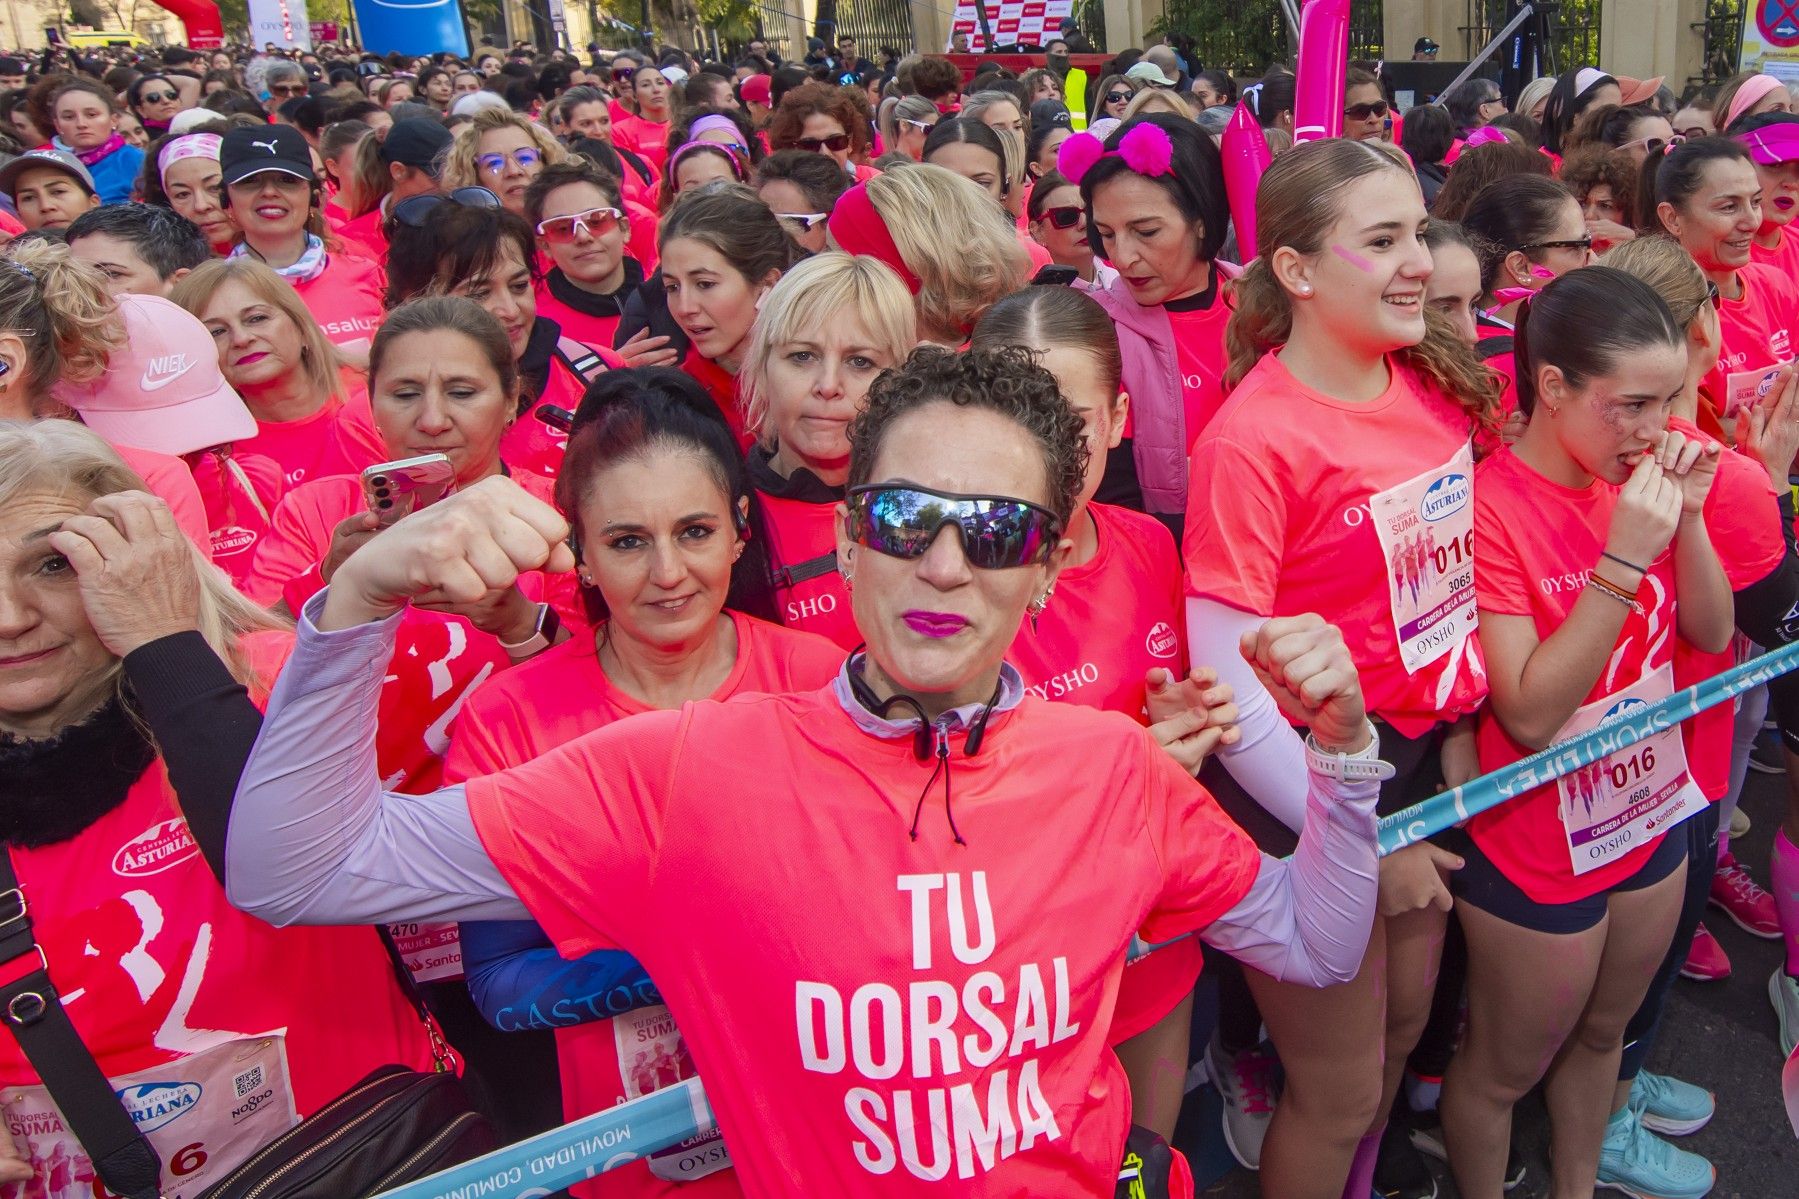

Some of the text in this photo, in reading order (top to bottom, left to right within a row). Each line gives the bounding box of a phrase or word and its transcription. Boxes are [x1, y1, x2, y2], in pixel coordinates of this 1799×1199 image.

[1391, 515, 1420, 536] SUMA
[1448, 572, 1471, 594] 3065
[1417, 607, 1444, 630] CARRERA
[1416, 621, 1455, 655] OYSHO
[1611, 746, 1656, 789] 016
[1628, 786, 1651, 805] 4608
[1589, 798, 1686, 859] OYSHO Santander
[1591, 818, 1621, 837] CARRERA
[1621, 814, 1630, 824] DE
[1629, 809, 1638, 820] LA
[136, 836, 171, 853] CENTRAL
[897, 870, 996, 970] TU
[398, 937, 431, 952] MUJER
[632, 1020, 645, 1030] TU
[795, 956, 1080, 1080] DORSAL
[141, 1087, 188, 1107] LECHERA
[10, 1120, 64, 1137] SUMA
[844, 1058, 1062, 1182] SUMA
[526, 1123, 632, 1176] MOVILIDAD,
